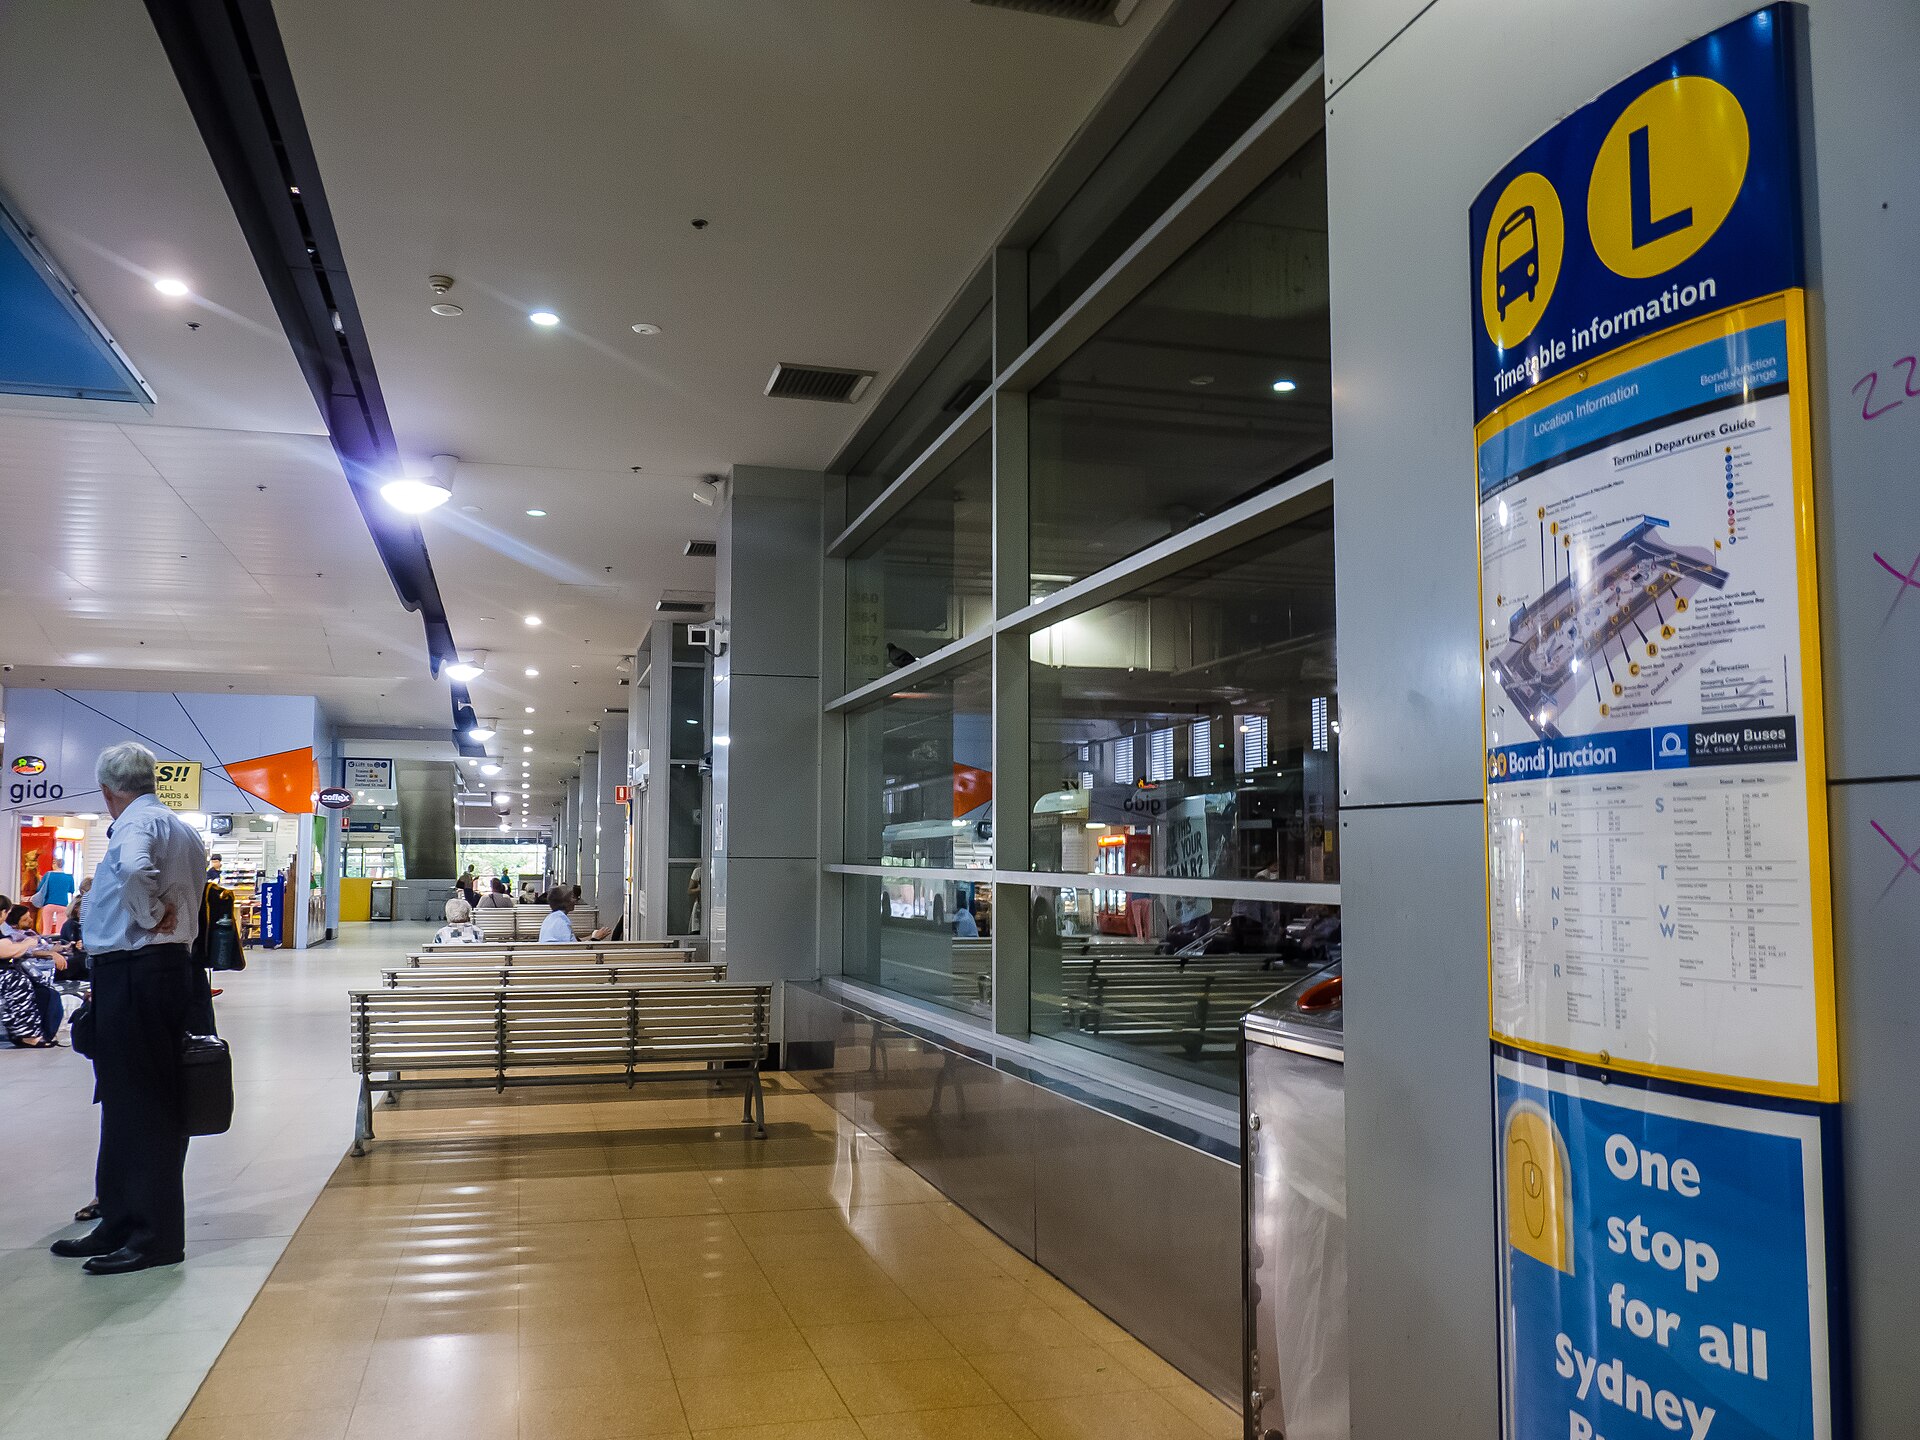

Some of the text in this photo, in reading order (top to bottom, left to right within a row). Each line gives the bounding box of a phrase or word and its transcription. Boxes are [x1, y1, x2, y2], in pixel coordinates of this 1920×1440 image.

[1628, 125, 1693, 250] L
[1493, 277, 1717, 397] Timetable information
[1700, 356, 1777, 387] Bondi Junction
[1714, 369, 1777, 394] Interchange
[1533, 382, 1639, 437] Location Information
[1612, 418, 1756, 467] Terminal Departures Guide
[1648, 644, 1656, 656] B
[1694, 728, 1787, 747] Sydney Buses
[1509, 742, 1617, 775] Bondi Junction
[156, 765, 190, 782] S!!
[10, 780, 63, 804] gido
[1549, 802, 1557, 816] H
[1655, 797, 1664, 813] S
[1181, 831, 1203, 860] YOUR
[1550, 839, 1559, 853] M
[1657, 864, 1668, 880] T
[1552, 886, 1560, 900] N
[1552, 917, 1559, 930] P
[1659, 904, 1670, 920] V
[1660, 922, 1675, 938] W
[1554, 964, 1561, 978] R
[1605, 1133, 1701, 1198] One
[1607, 1214, 1720, 1293] stop
[1609, 1283, 1768, 1381] for all
[1555, 1332, 1716, 1440] Sydney
